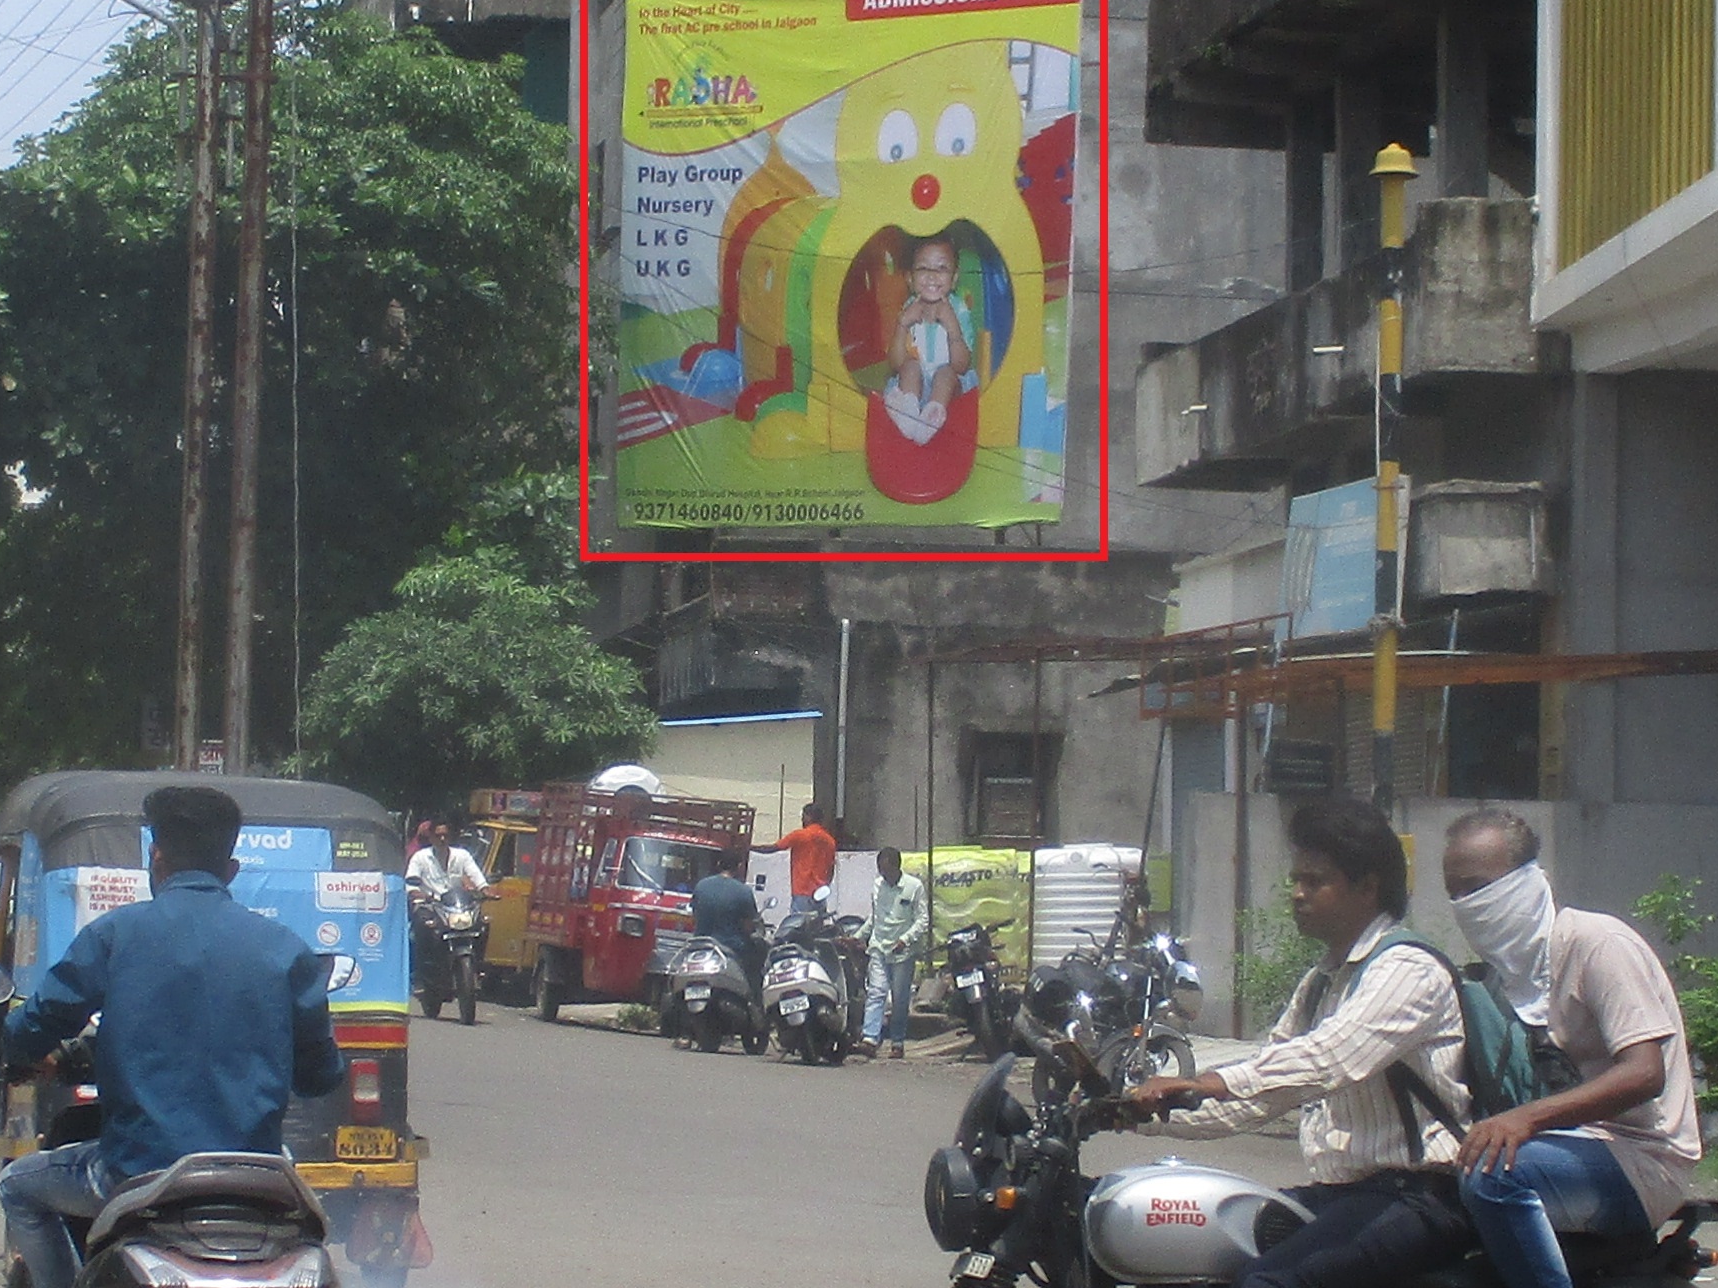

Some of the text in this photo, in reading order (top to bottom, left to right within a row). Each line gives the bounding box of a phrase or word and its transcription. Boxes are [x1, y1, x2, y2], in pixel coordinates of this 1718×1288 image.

[653, 7, 670, 18] the
[719, 2, 741, 16] City
[639, 23, 658, 35] The
[685, 23, 700, 33] AC
[703, 23, 720, 34] pre
[723, 18, 759, 31] school
[762, 19, 772, 29] in
[776, 16, 817, 30] Jalgaon
[654, 75, 757, 107] RADHA
[706, 116, 748, 127] Preschool
[637, 164, 743, 187] Play Group
[637, 196, 714, 217] Nursery
[636, 228, 688, 246] L K G
[636, 259, 691, 277] U K G
[634, 502, 865, 522] 9371460840/9130006466
[100, 875, 138, 884] QUALITY
[326, 881, 381, 892] ashirvad
[90, 894, 136, 903] ASHIRVAD
[1151, 1197, 1201, 1212] ROYAL
[1146, 1212, 1206, 1227] ENFIELD
